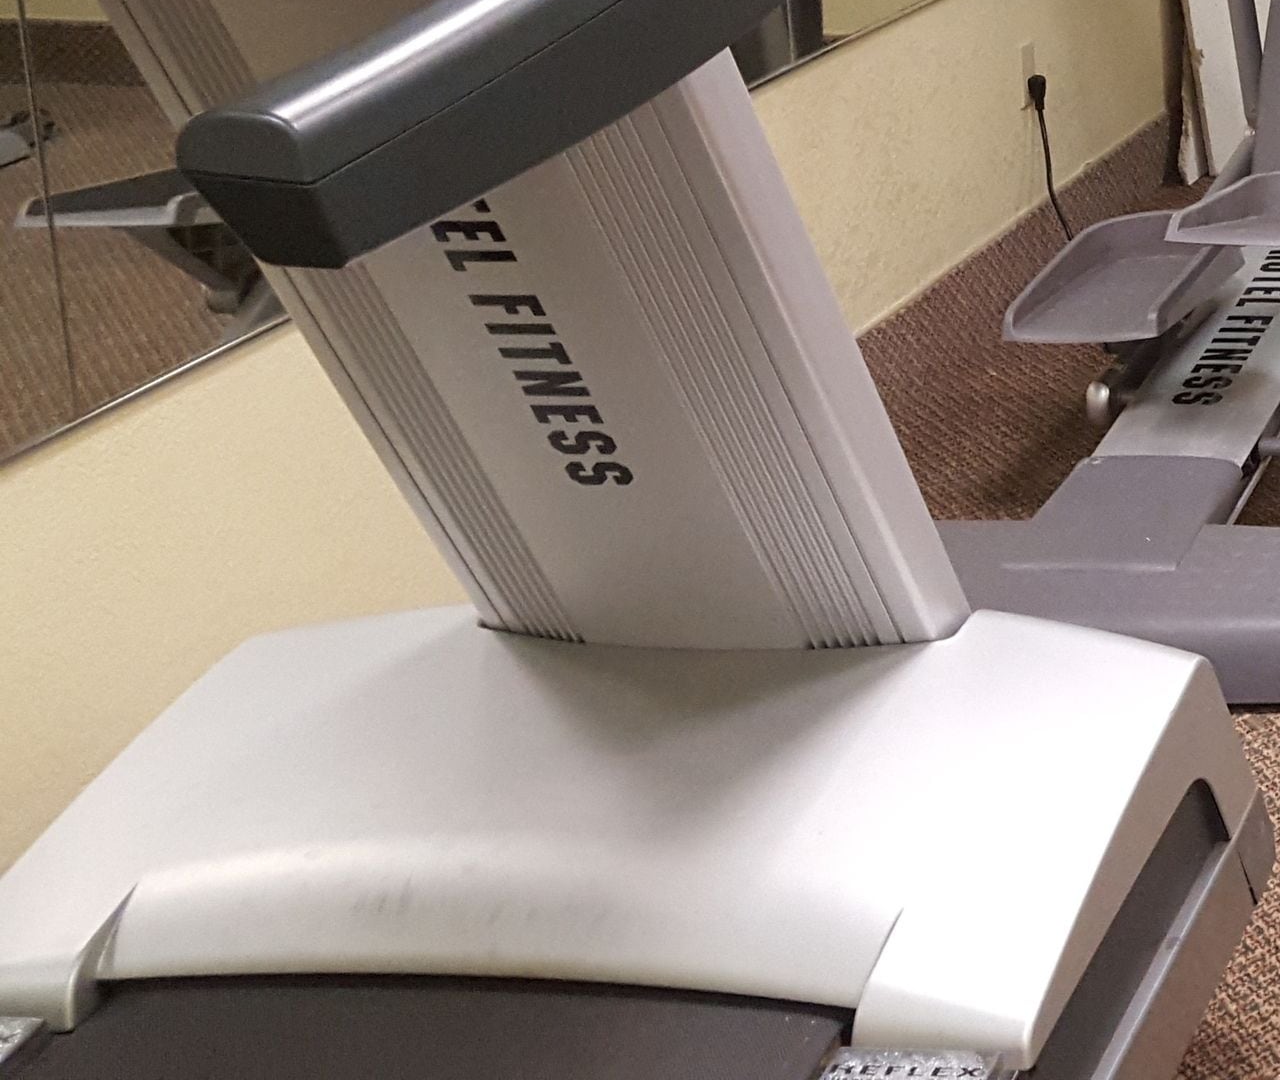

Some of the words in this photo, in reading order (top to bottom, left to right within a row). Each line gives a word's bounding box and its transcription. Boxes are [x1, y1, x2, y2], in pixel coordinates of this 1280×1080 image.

[468, 294, 634, 486] FITNESS
[1171, 315, 1275, 406] FITNESS
[829, 1063, 985, 1078] REFLEX
